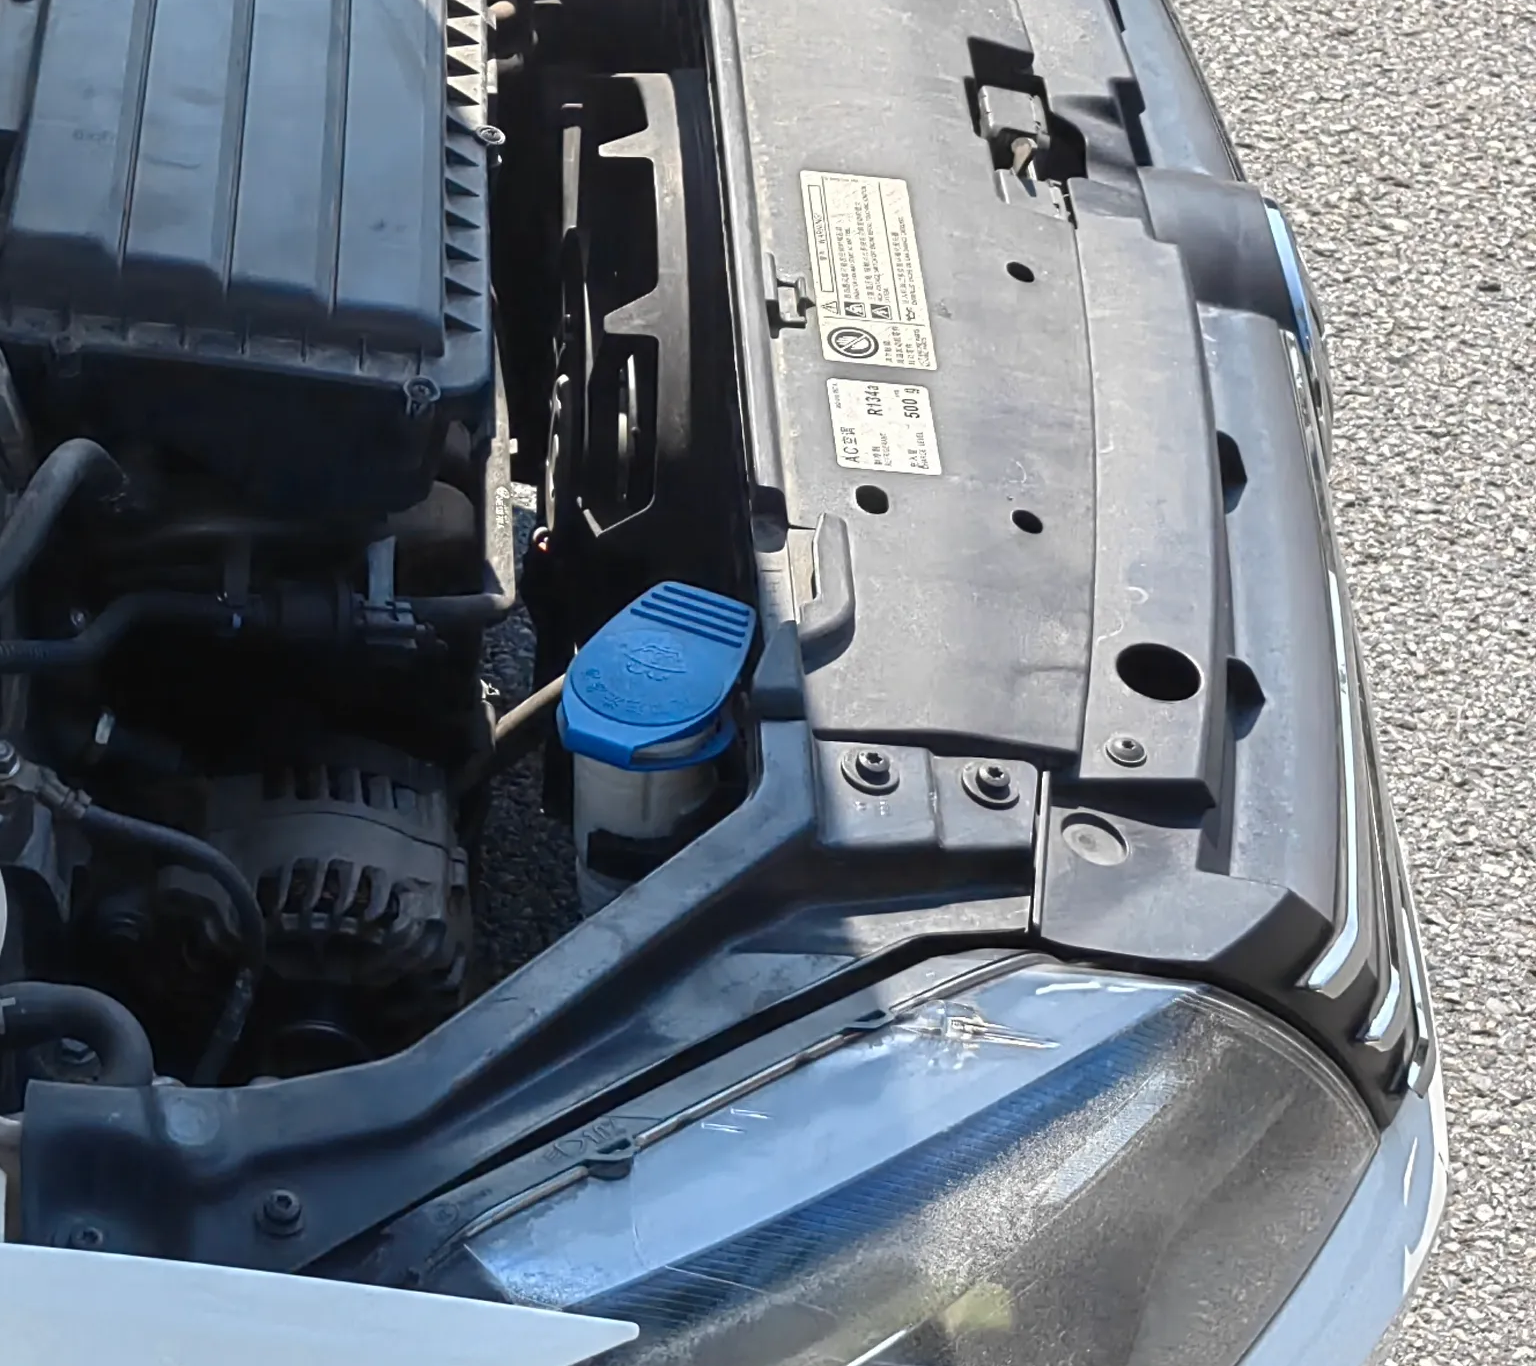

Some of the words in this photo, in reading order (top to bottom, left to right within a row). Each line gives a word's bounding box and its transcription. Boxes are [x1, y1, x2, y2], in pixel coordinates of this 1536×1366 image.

[813, 211, 825, 244] WARNING
[864, 384, 883, 416] R134a
[901, 398, 920, 419] 500
